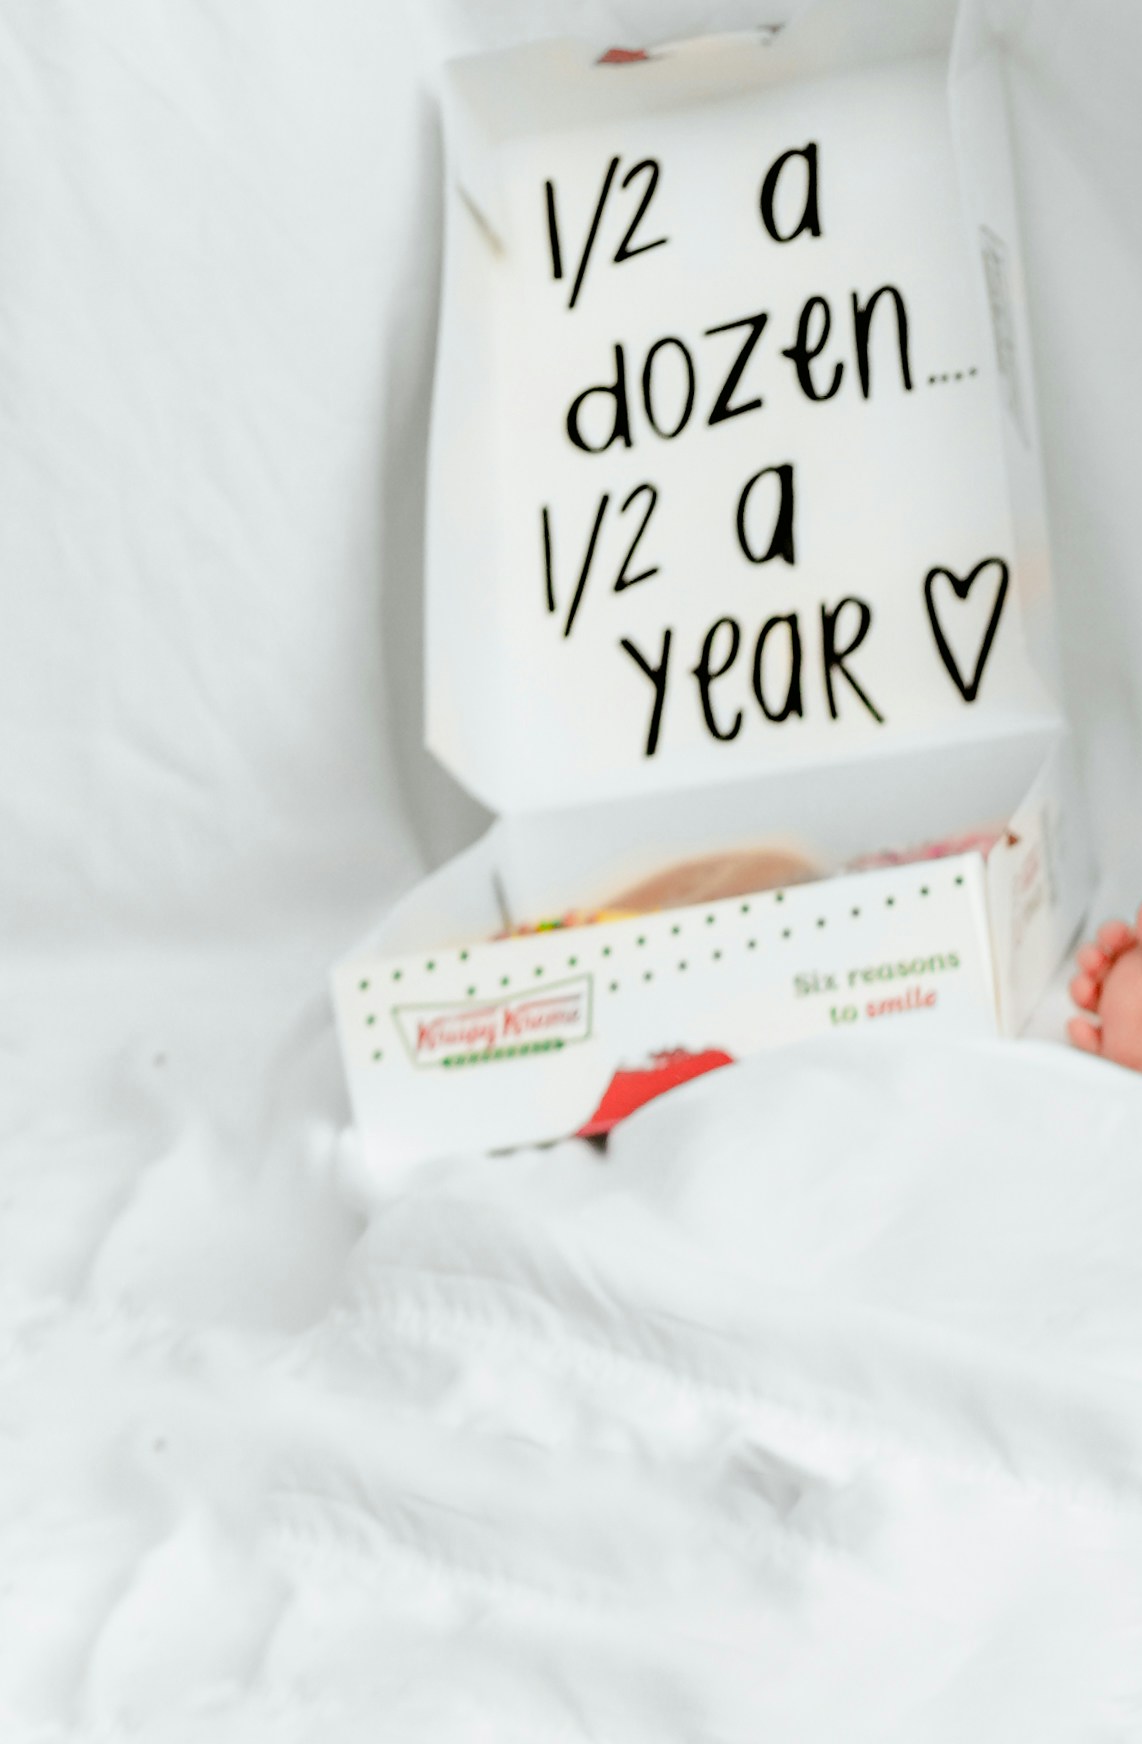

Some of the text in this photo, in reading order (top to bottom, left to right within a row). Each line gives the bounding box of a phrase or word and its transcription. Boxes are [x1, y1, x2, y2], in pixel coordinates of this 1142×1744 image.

[543, 141, 823, 309] 1/2 a
[541, 462, 796, 638] 1/2 a
[793, 951, 960, 996] Six reasons
[829, 987, 937, 1024] to smile
